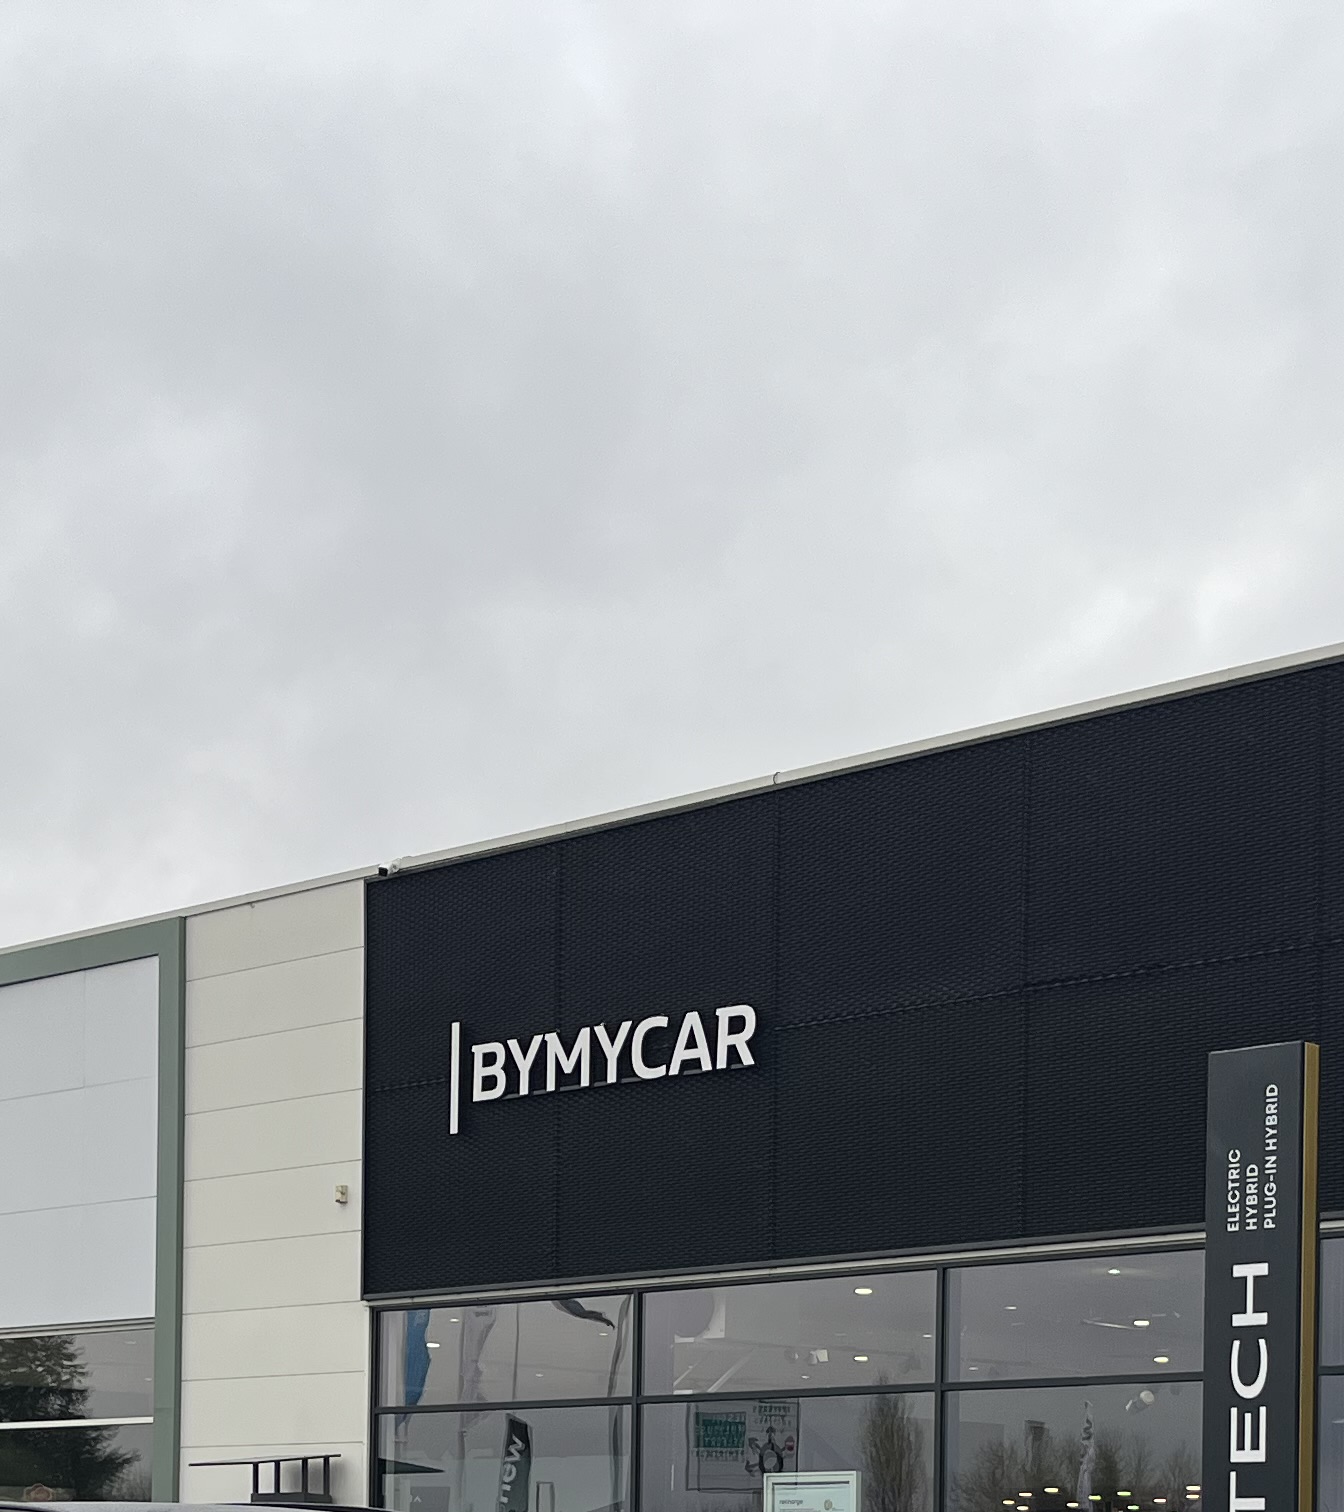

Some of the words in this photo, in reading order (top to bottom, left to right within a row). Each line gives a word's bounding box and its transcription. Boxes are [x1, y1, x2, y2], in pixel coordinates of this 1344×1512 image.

[471, 1004, 756, 1103] BYMYCAR
[1264, 1084, 1279, 1151] HYBRID
[1227, 1149, 1241, 1232] ELECTRIC
[1245, 1163, 1259, 1231] HYBRID
[1263, 1155, 1278, 1229] PLUG-IN
